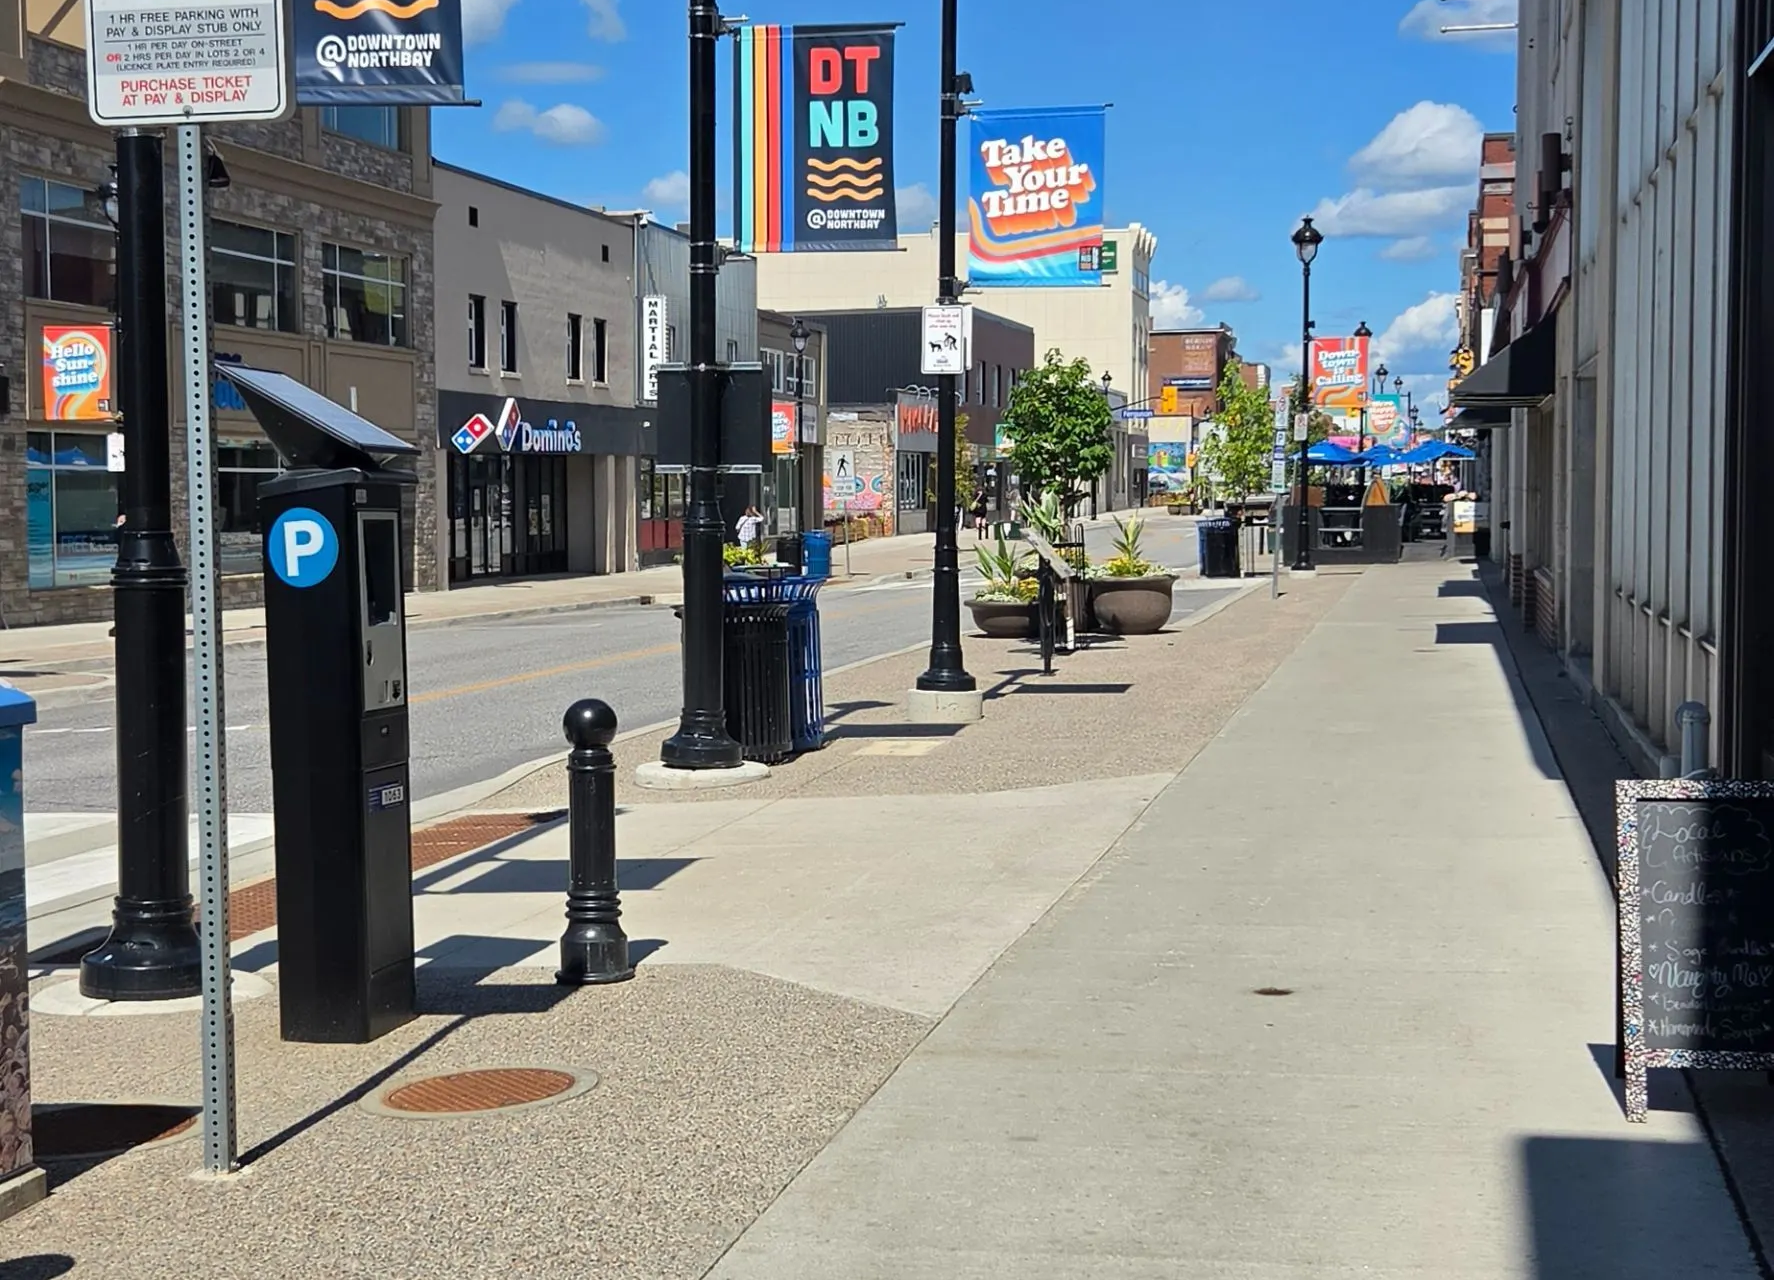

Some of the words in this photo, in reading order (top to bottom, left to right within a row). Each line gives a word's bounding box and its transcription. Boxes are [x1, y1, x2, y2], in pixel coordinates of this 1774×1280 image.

[110, 15, 115, 24] 1
[120, 13, 135, 24] HR
[141, 12, 169, 23] FREE
[175, 9, 225, 21] PARKING
[229, 8, 259, 19] WITH
[106, 27, 127, 38] PAY
[132, 26, 139, 36] &
[145, 24, 192, 36] DISPLAY
[197, 22, 228, 34] STUB
[233, 21, 262, 32] ONLY
[135, 43, 147, 51] HR
[151, 42, 168, 50] PER
[171, 41, 188, 49] DAY
[191, 38, 243, 48] ON-STREET
[106, 53, 122, 63] OR
[133, 52, 151, 61] HRS
[155, 51, 172, 60] PER
[175, 51, 192, 59] DAY
[195, 50, 204, 58] IN
[207, 49, 230, 58] LOTS
[243, 48, 256, 56] OR
[259, 47, 265, 55] 4
[347, 51, 433, 68] NORTHBAY
[156, 61, 180, 70] PLATE
[183, 60, 208, 69] ENTRY
[809, 45, 881, 95] DT
[121, 77, 197, 93] PURCHASE
[202, 75, 252, 89] TICKET
[122, 94, 138, 106] AT
[144, 93, 168, 105] PAY
[174, 91, 184, 104] &
[191, 90, 248, 103] DISPLAY
[809, 100, 880, 148] NB
[981, 134, 1067, 168] Take
[1003, 163, 1088, 194] Your
[981, 188, 1070, 218] Time
[827, 219, 880, 230] NORTHBAY
[648, 301, 658, 359] MARTIAL
[50, 343, 95, 359] Hello
[55, 358, 94, 372] Sun-
[52, 371, 98, 388] shine
[520, 419, 582, 452] Domino's
[284, 520, 325, 577] P
[1652, 816, 1728, 843] Local
